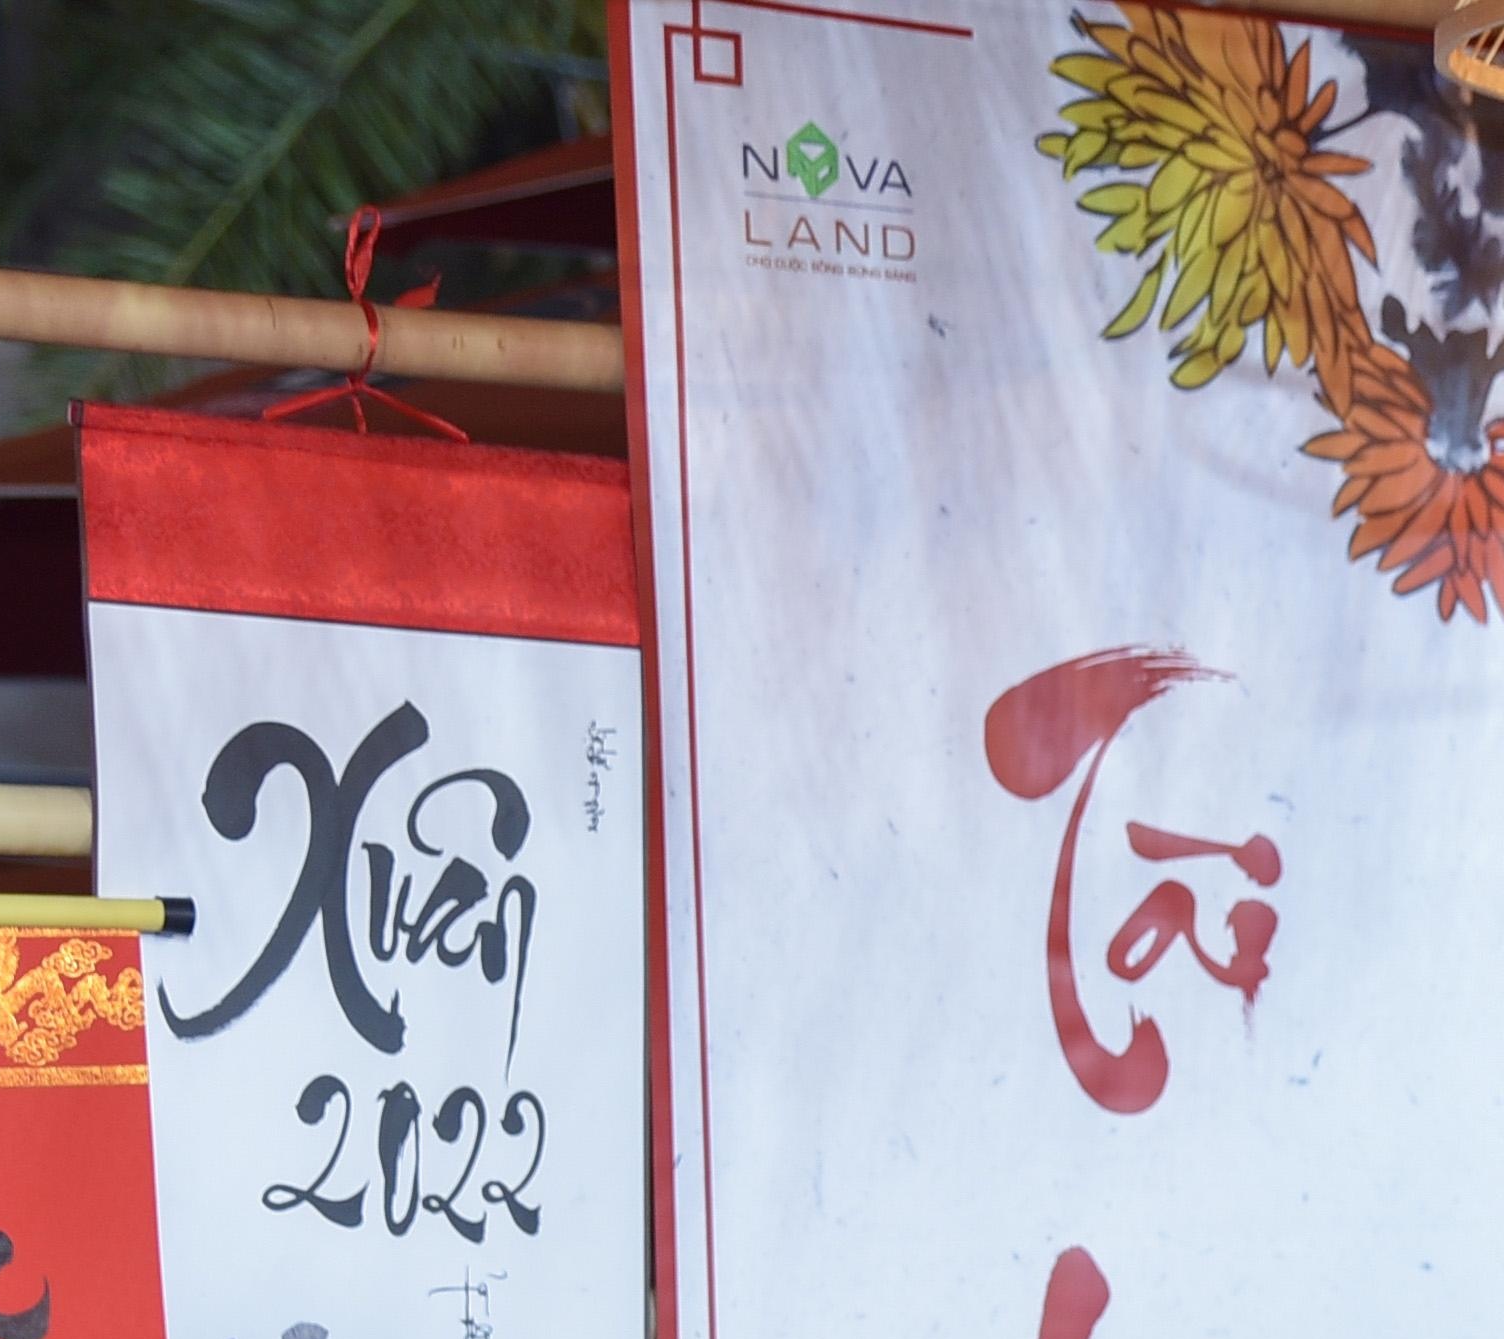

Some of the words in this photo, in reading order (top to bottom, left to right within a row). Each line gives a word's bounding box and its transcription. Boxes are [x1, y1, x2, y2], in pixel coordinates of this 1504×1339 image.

[742, 121, 913, 198] NOVA
[745, 209, 915, 261] LAND
[158, 699, 538, 1085] Xuân
[984, 641, 1283, 1115] Tài
[262, 1074, 546, 1244] 2022
